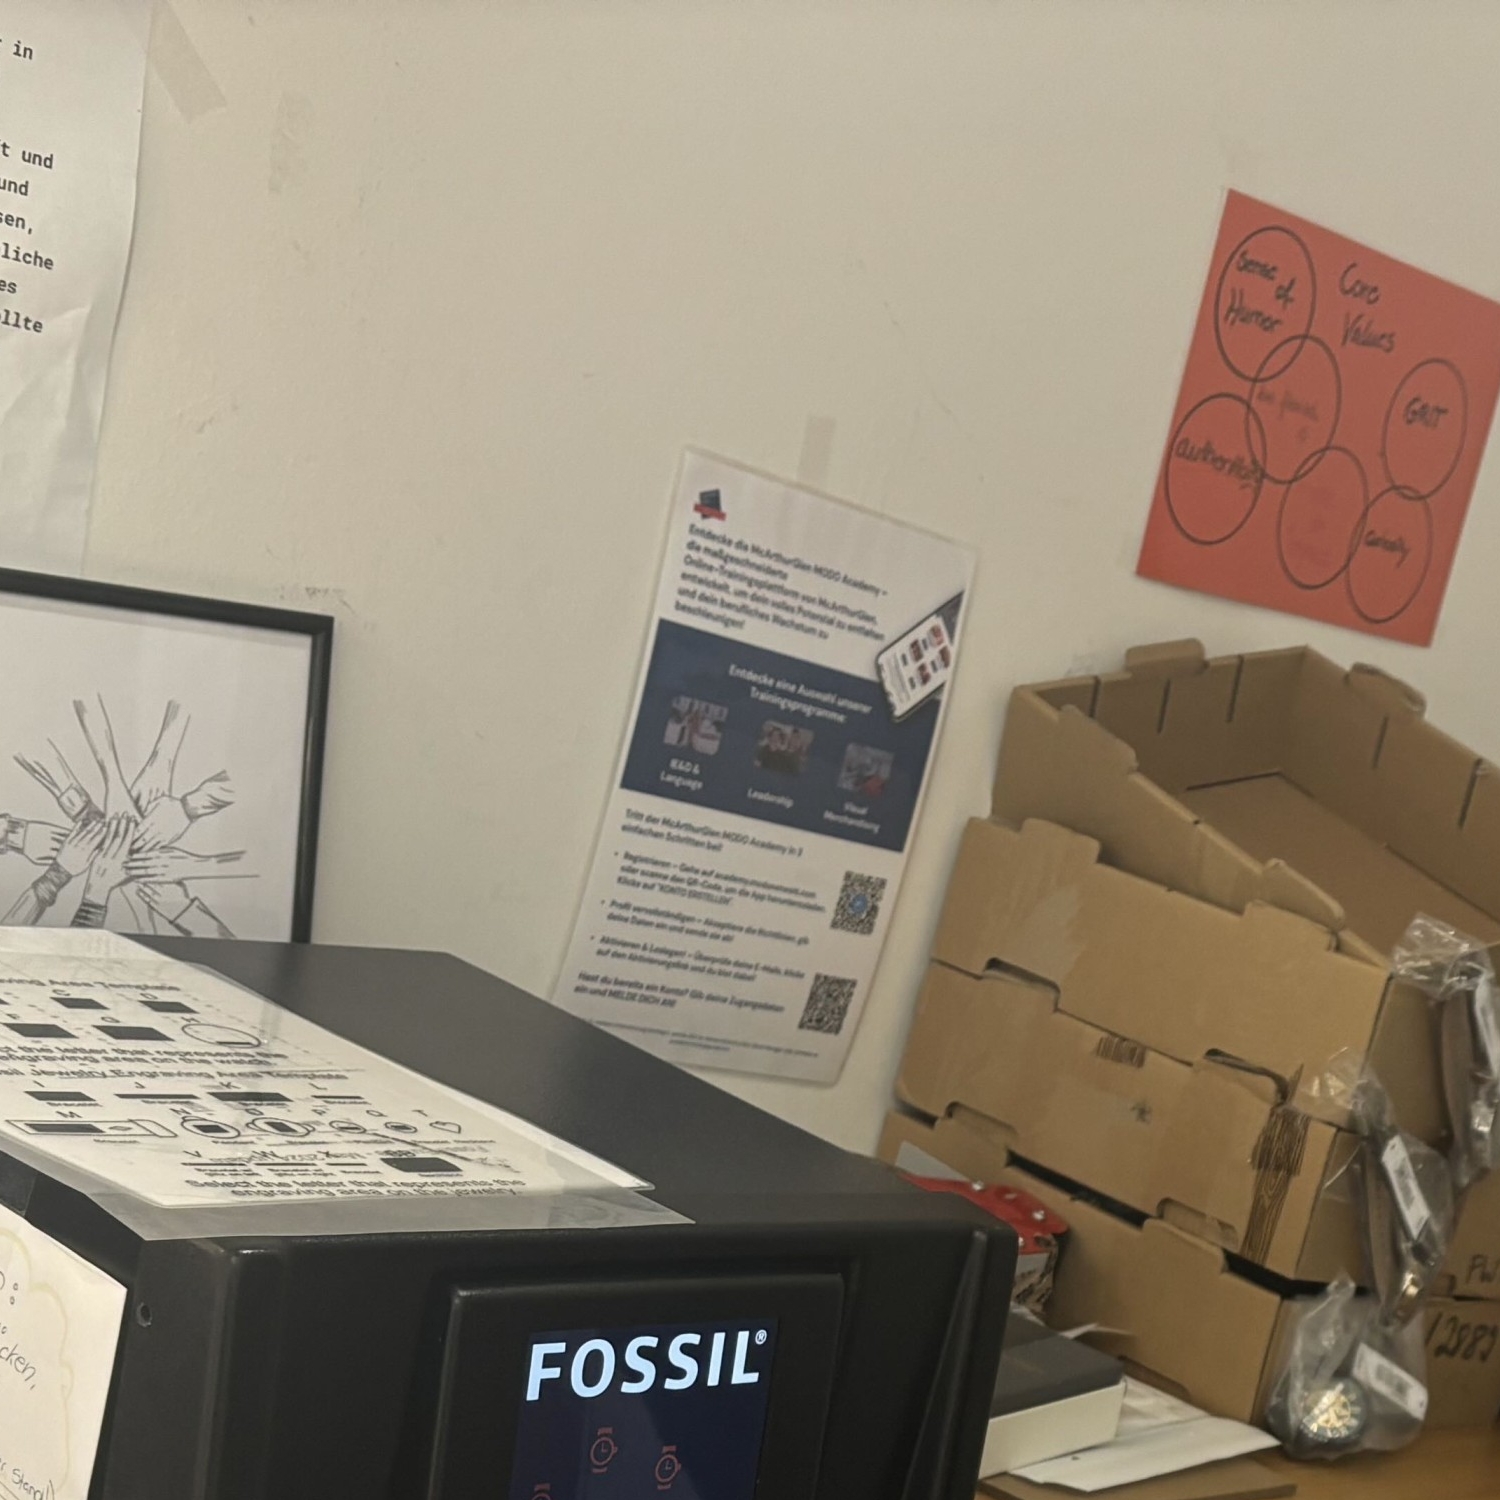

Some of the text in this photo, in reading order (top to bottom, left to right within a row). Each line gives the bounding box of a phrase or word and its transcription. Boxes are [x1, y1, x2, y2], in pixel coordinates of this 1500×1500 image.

[13, 40, 33, 60] in
[22, 150, 53, 169] und
[1339, 262, 1380, 304] Core
[1275, 277, 1296, 311] of
[1341, 312, 1395, 353] Values
[685, 539, 701, 553] die
[688, 524, 733, 547] Entdecke
[734, 538, 749, 551] die
[676, 586, 696, 599] und
[186, 1180, 254, 1188] Select
[392, 1181, 492, 1189] represents
